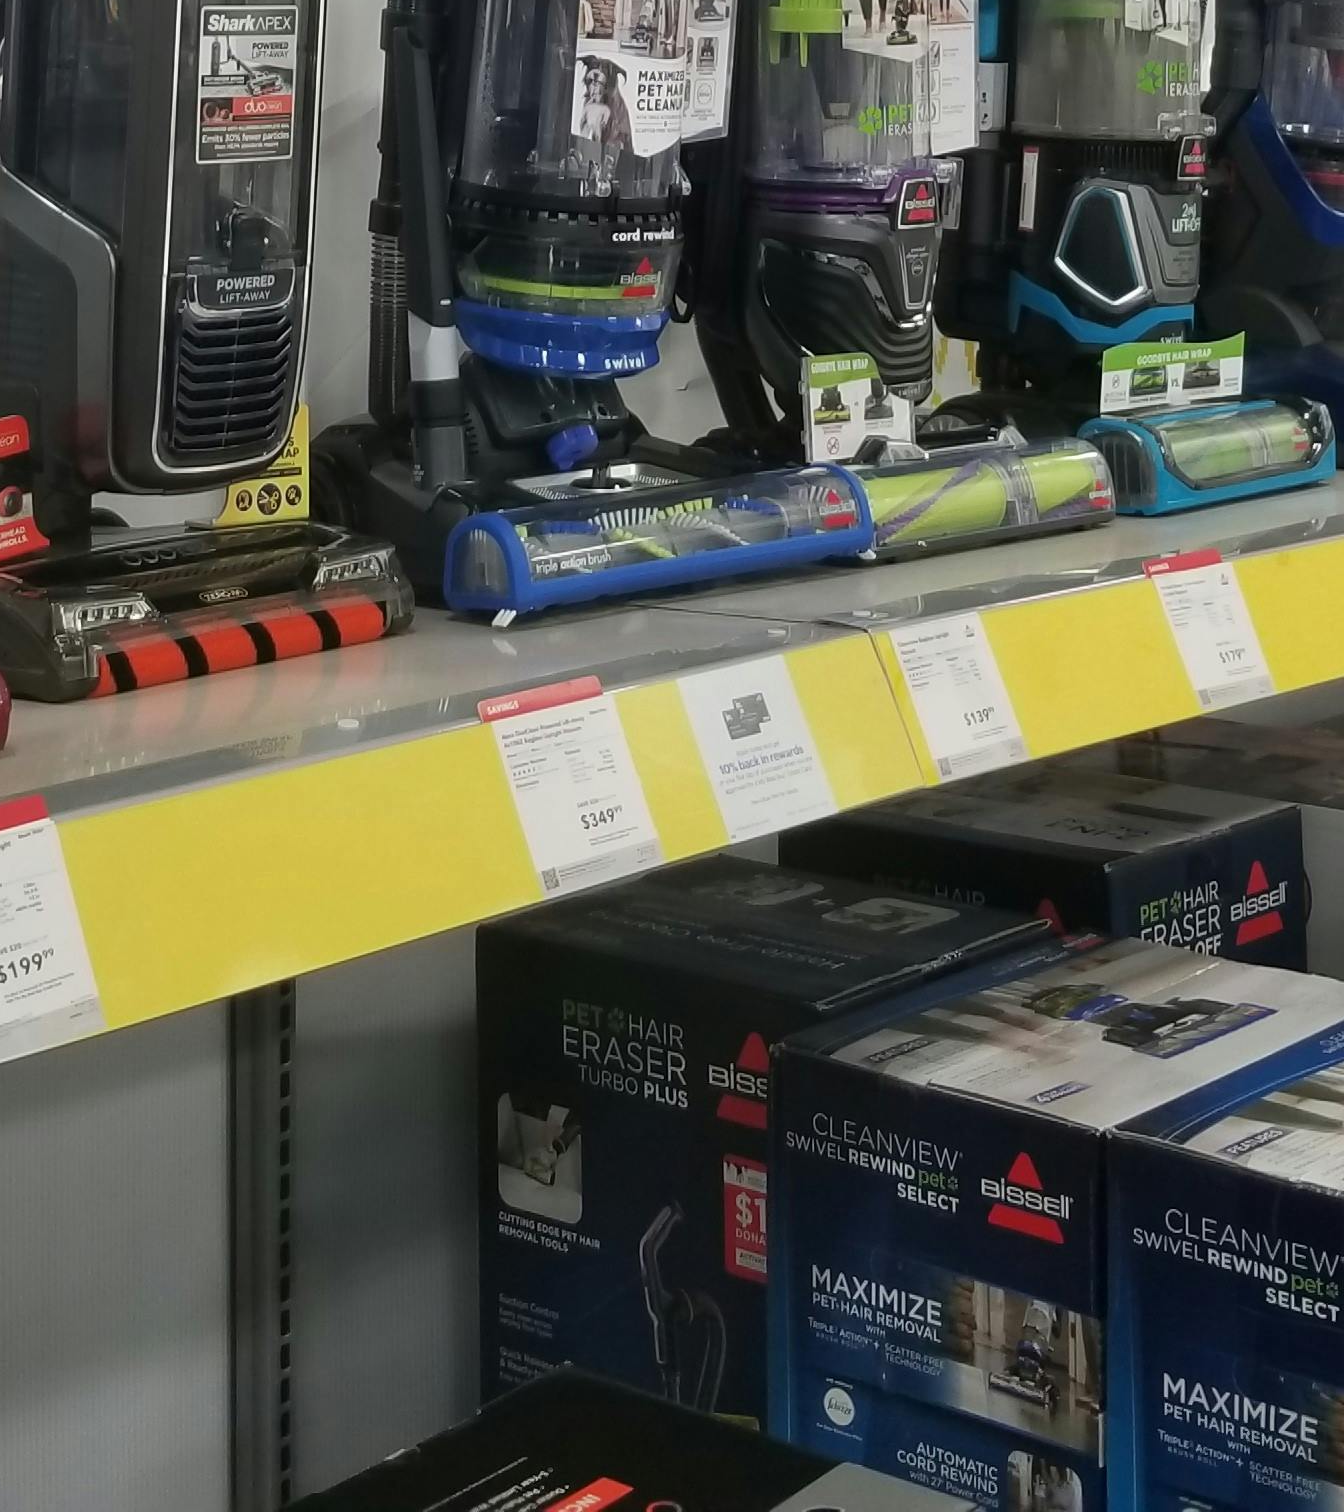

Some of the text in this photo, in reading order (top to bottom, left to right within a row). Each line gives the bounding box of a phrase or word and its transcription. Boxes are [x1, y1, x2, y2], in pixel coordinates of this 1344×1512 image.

[207, 14, 292, 32] Shark APEX
[612, 226, 675, 242] cord rewind
[216, 274, 275, 291] POWERED
[220, 290, 271, 304] LIFT-AWAY
[604, 352, 646, 369] swivel
[1136, 347, 1212, 366] GOODBYE HAIR WRAP
[535, 550, 612, 574] triple action brush
[487, 700, 520, 716] SAVINGS
[719, 745, 805, 775] 10% back in rewards
[1140, 879, 1219, 926] PET HAIR
[562, 998, 684, 1049] PET HAIR
[562, 1024, 687, 1086] ERASER
[578, 1064, 689, 1108] TURBO PLUS
[785, 1131, 946, 1189] SWIVEL REWIND pet
[811, 1112, 962, 1172] CLEANVIEW
[896, 1182, 960, 1214] SELECT
[498, 1211, 601, 1250] CUTTING EDGE PET HAIR
[498, 1224, 539, 1245] REMOVAL
[1165, 1208, 1344, 1278] CLEANVIEW
[1132, 1227, 1324, 1297] SWIVEL REWIND pet
[811, 1264, 943, 1326] MAXIMIZE
[1265, 1287, 1341, 1324] SELECT
[812, 1291, 836, 1310] PET
[840, 1300, 873, 1321] HAIR
[876, 1310, 942, 1344] REMOVAL
[865, 1324, 886, 1337] WITH
[1162, 1372, 1319, 1446] MAXIMIZE
[1163, 1402, 1318, 1464] PET HAIR REMOVAL
[1227, 1440, 1251, 1455] WITH
[896, 1449, 999, 1495] CORD REWIND
[916, 1441, 999, 1482] AUTOMATIC
[1249, 1471, 1317, 1500] TECHNOLOGY
